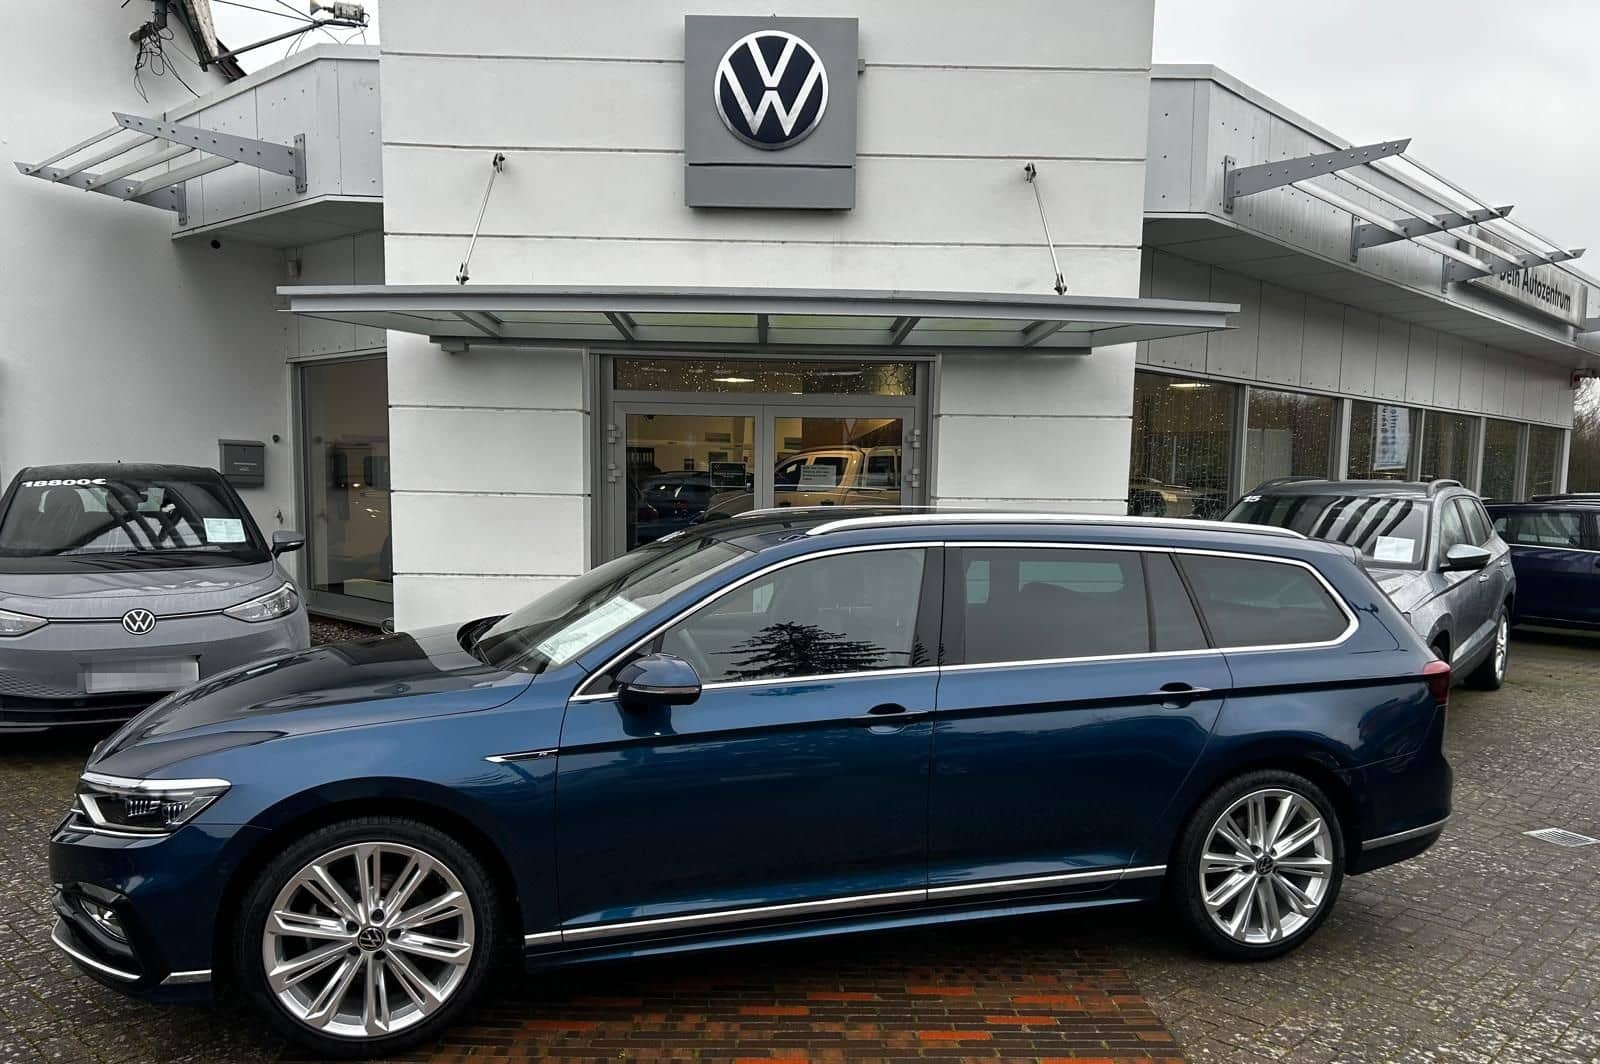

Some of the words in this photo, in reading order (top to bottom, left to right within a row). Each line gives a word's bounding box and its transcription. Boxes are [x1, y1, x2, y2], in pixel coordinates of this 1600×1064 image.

[715, 31, 828, 148] VW
[1522, 268, 1571, 312] Autozentrum
[122, 608, 156, 635] VW
